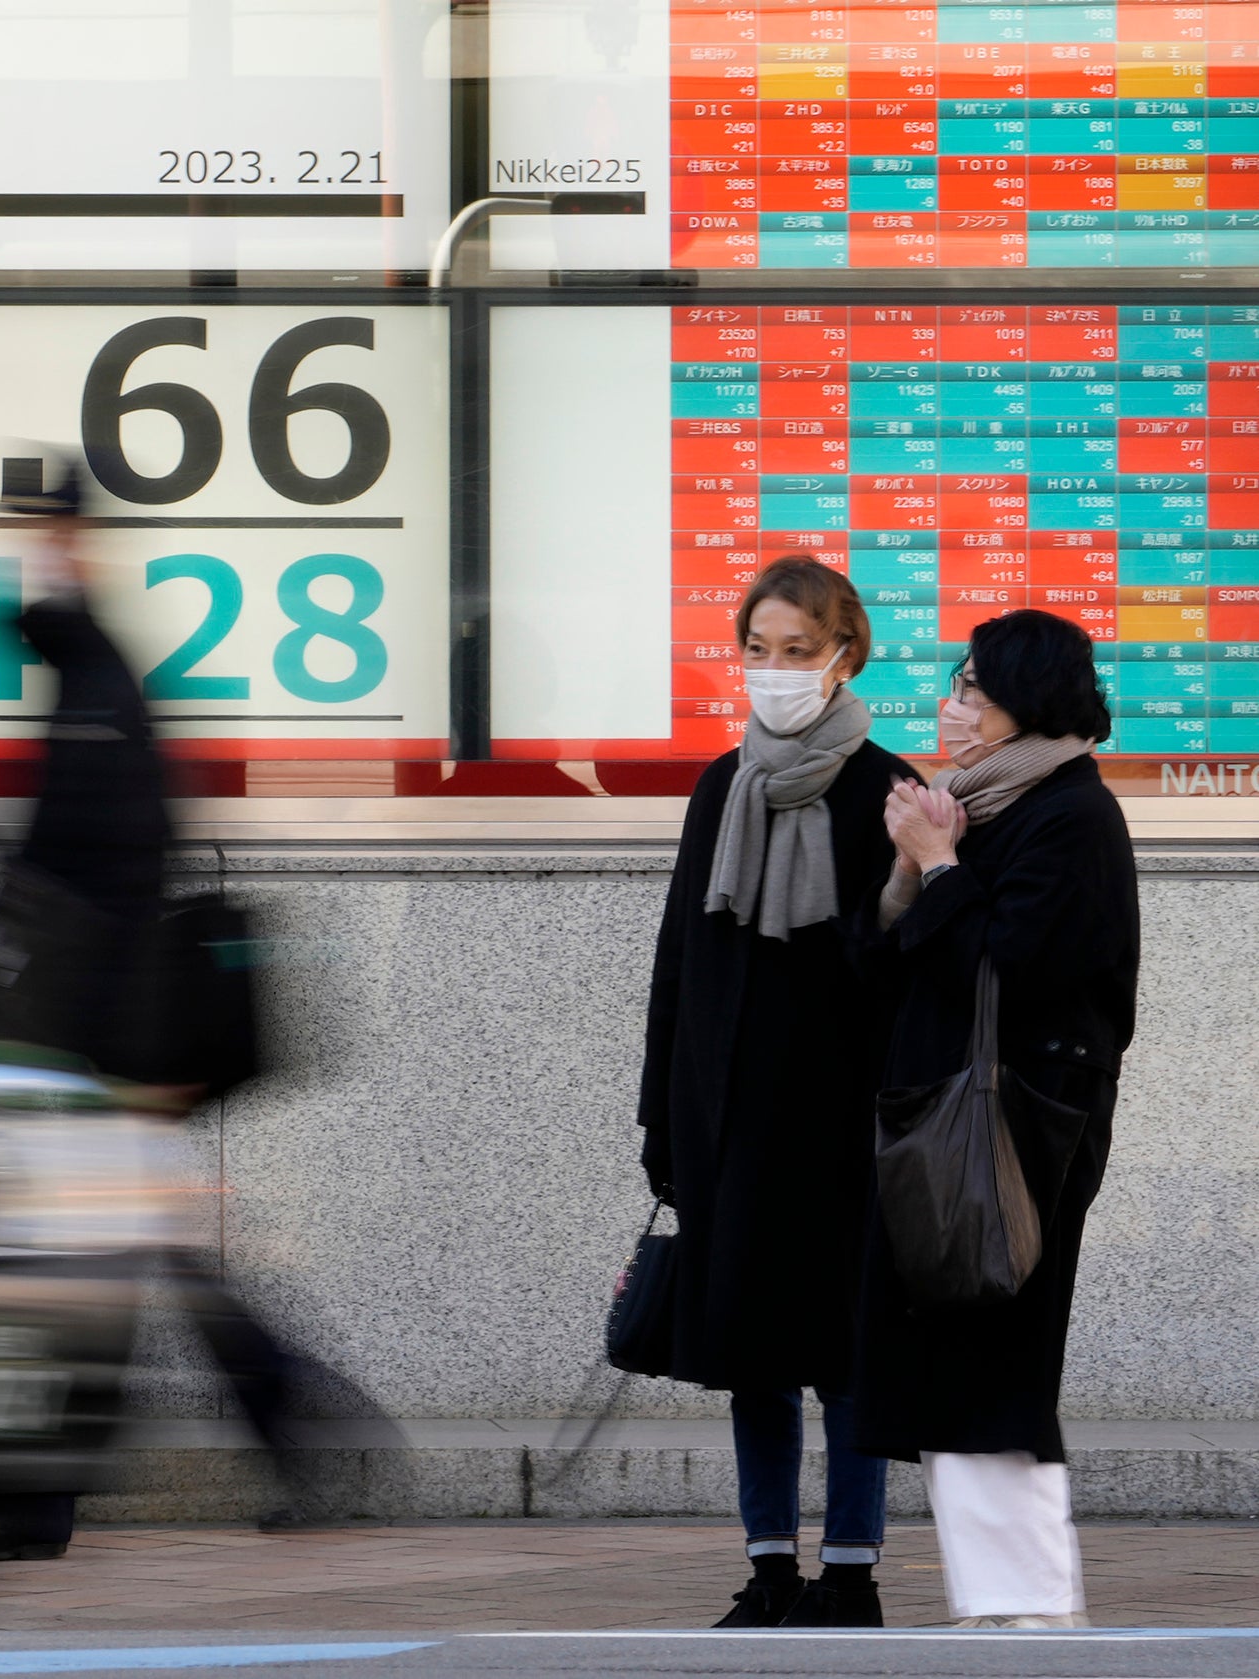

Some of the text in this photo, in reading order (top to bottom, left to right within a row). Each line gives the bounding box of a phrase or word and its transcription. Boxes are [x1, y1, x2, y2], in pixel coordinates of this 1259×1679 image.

[964, 47, 999, 58] UBE
[993, 66, 1023, 77] 2077
[1175, 65, 1205, 76] 5116
[908, 84, 934, 95] +9.0
[1091, 84, 1114, 94] +40
[695, 105, 732, 115] DIC
[785, 104, 822, 115] ZHD
[1051, 103, 1090, 114] 楽天G
[725, 123, 755, 134] 2450
[904, 122, 934, 133] 6540
[994, 121, 1025, 133] 1190
[732, 141, 754, 152] +21
[818, 141, 845, 152] +2.2
[911, 140, 935, 151] +40
[1003, 140, 1025, 151] -10
[1093, 139, 1115, 151] -10
[1183, 139, 1204, 150] -38
[159, 150, 386, 184] 2023. 2.21
[958, 160, 1007, 170] TOTO
[1052, 159, 1092, 171] ガイシ
[496, 159, 641, 184] Nikkei225
[993, 178, 1024, 188] 4610
[1173, 177, 1204, 188] 3097
[733, 197, 755, 208] +35
[822, 197, 845, 208] +35
[1001, 196, 1024, 207] +40
[1091, 196, 1114, 206] +12
[689, 217, 738, 228] DOWA
[873, 216, 913, 228] 住友電
[958, 216, 1008, 227] フジクラ
[1047, 215, 1098, 226] しずおか
[725, 235, 756, 246] 4545
[895, 234, 935, 245] 1674.0
[1001, 234, 1025, 245] 976
[733, 253, 757, 264] +30
[908, 252, 935, 263] +4.5
[1001, 252, 1024, 263] +10
[688, 310, 741, 321] ダイキン
[875, 310, 912, 321] NTN
[719, 329, 756, 340] 23520
[823, 329, 846, 339] 753
[912, 329, 935, 339] 339
[996, 329, 1025, 339] 1019
[1084, 329, 1113, 339] 2411
[726, 347, 756, 358] +170
[1092, 347, 1114, 357] +30
[868, 366, 918, 377] ソニーG
[965, 366, 1000, 377] TDK
[716, 384, 757, 397] 1177.0
[822, 385, 846, 396] 979
[899, 384, 936, 396] 11425
[994, 384, 1025, 395] 4495
[1173, 383, 1205, 395] 2057
[732, 402, 757, 414] -3.5
[915, 402, 936, 414] -15
[1004, 402, 1025, 414] -55
[1093, 402, 1115, 413] -16
[1183, 401, 1205, 413] -14
[689, 422, 741, 434] 三井E&S
[785, 422, 824, 434] 日立造
[1056, 421, 1089, 433] IHI
[733, 441, 756, 452] 430
[905, 440, 936, 452] 5033
[994, 440, 1025, 452] 3010
[1084, 440, 1115, 452] 3625
[1181, 440, 1204, 451] 577
[916, 458, 936, 470] -13
[1004, 458, 1025, 470] -15
[784, 479, 823, 490] ニコン
[957, 478, 1009, 490] スクリン
[1048, 478, 1097, 489] HOYA
[726, 497, 757, 508] 3405
[733, 515, 757, 526] +30
[826, 514, 844, 526] -11
[908, 515, 935, 526] +1.5
[994, 515, 1025, 526] +150
[1095, 512, 1115, 526] -25
[1180, 514, 1205, 526] -2.0
[784, 534, 824, 546] 三井物
[963, 533, 1003, 546] 住友商
[1053, 533, 1093, 546] 三菱商
[726, 553, 756, 564] 5600
[897, 553, 936, 564] 45290
[984, 553, 1025, 564] 2373.0
[909, 570, 936, 583] -190
[991, 571, 1024, 582] +11.5
[1091, 571, 1114, 581] +64
[1185, 570, 1205, 581] -17
[688, 590, 741, 601] ふくおか
[957, 590, 1008, 602] 大和証G
[1046, 590, 1098, 602] 野村HD
[1142, 590, 1182, 602] 松井証
[895, 608, 936, 621] 2418.0
[1181, 609, 1205, 620] 805
[912, 626, 936, 638] -8.5
[694, 645, 735, 658] 住友不
[906, 664, 936, 676] 1609
[916, 682, 936, 694] -22
[1184, 682, 1205, 694] -45
[869, 702, 917, 714] KDDI
[906, 720, 936, 732] 4024
[1175, 720, 1205, 732] 1436
[916, 738, 936, 750] -15
[1185, 739, 1205, 750] -14
